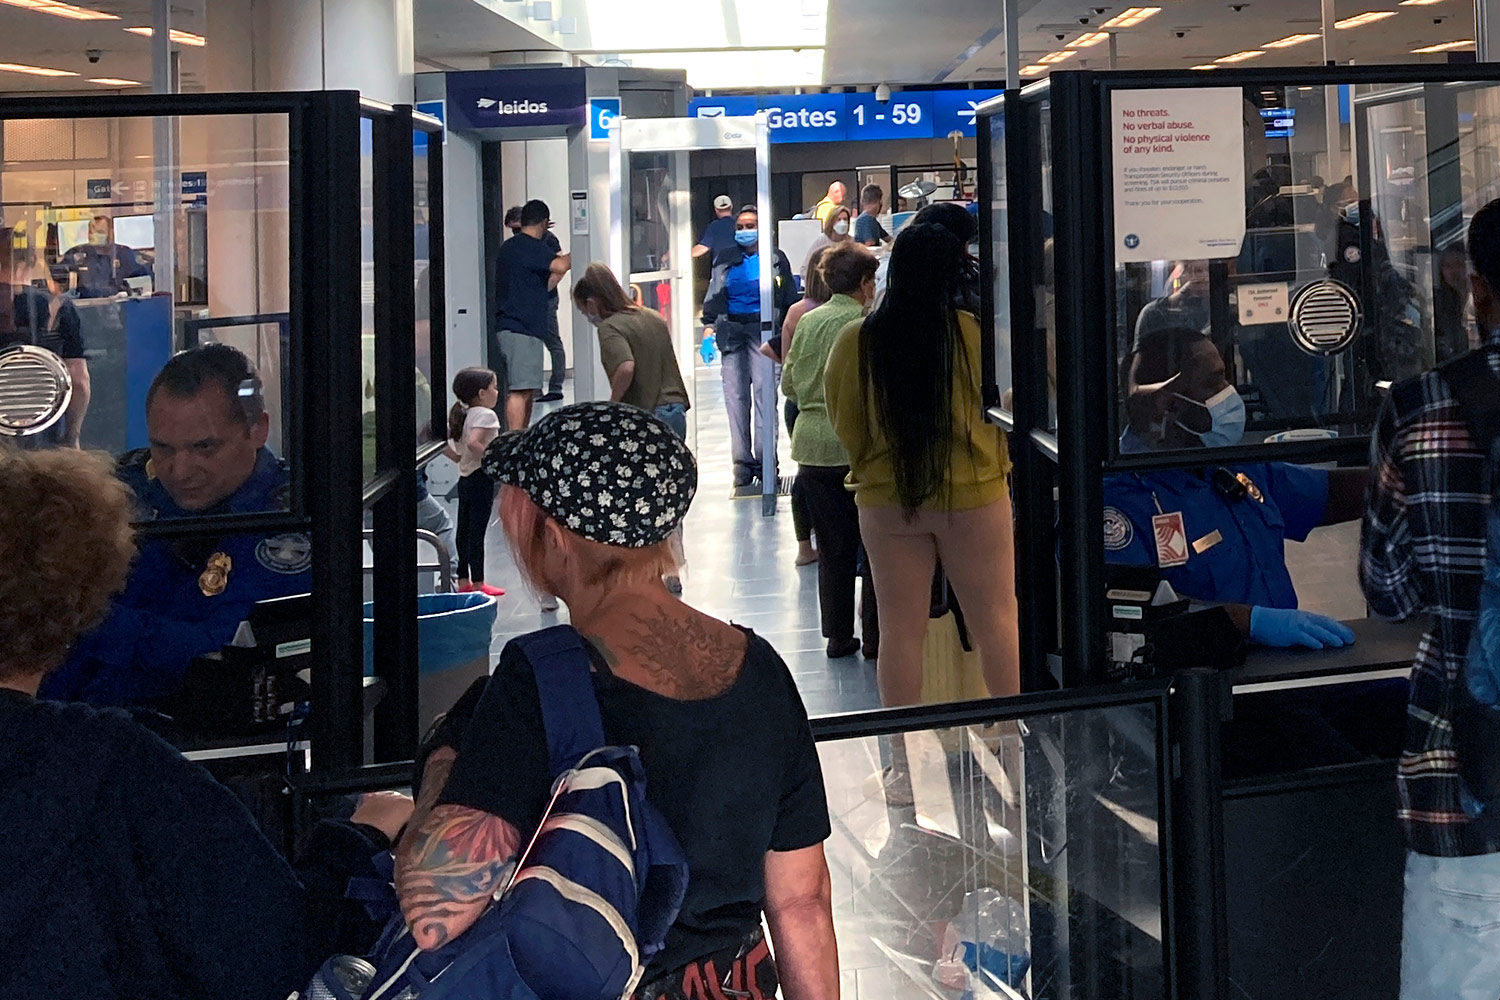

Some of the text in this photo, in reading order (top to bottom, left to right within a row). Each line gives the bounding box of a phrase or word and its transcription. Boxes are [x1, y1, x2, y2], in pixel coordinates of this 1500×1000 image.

[498, 99, 548, 115] leidos
[598, 109, 610, 130] 6
[767, 107, 837, 129] Gates
[853, 104, 864, 126] 1
[892, 103, 922, 125] 59
[1122, 109, 1170, 118] No threats.
[1138, 122, 1165, 130] verbal
[1167, 121, 1194, 129] abuse.
[1138, 134, 1173, 145] physical
[1175, 133, 1210, 142] violence
[1123, 144, 1174, 155] of any kind.
